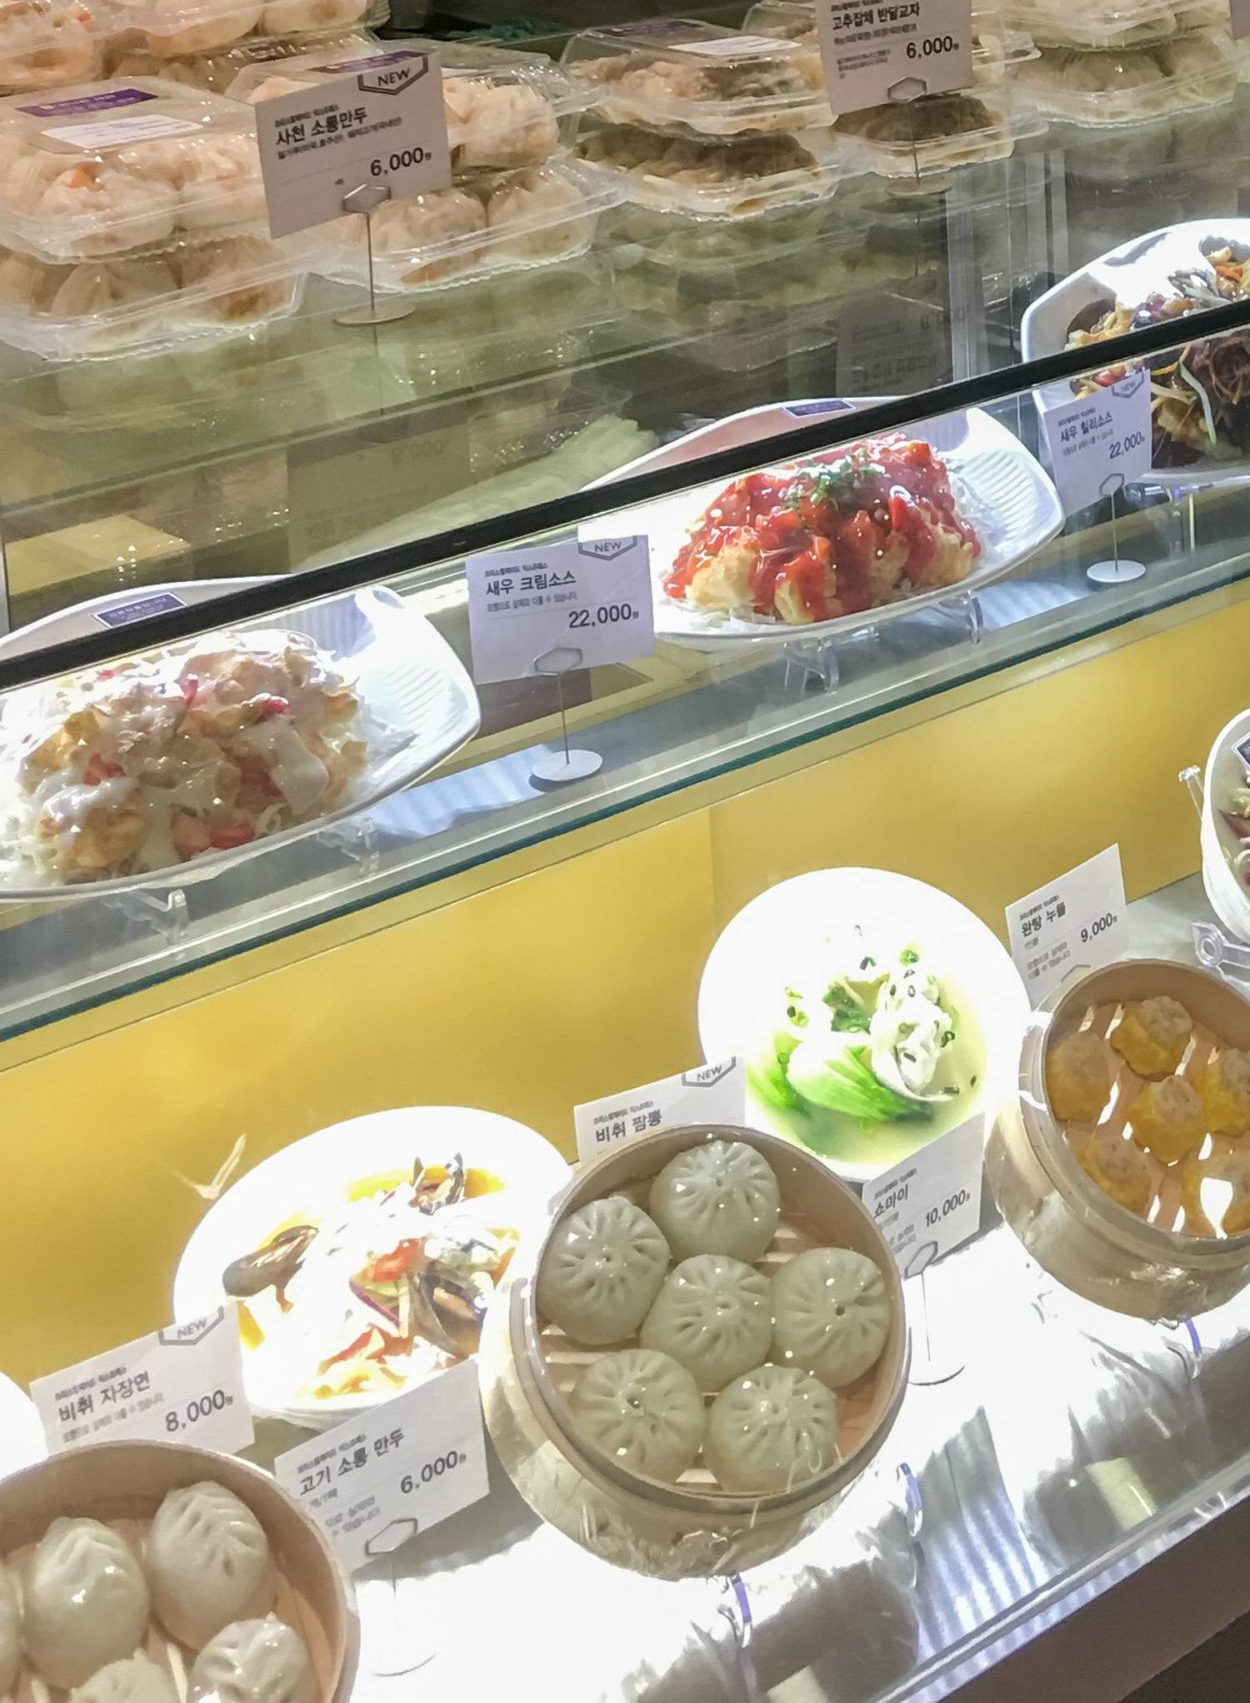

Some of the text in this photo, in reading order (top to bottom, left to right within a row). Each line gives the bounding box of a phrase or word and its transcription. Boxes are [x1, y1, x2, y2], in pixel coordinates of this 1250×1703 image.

[377, 68, 411, 87] NEW
[276, 125, 305, 146] 사천
[594, 541, 622, 553] NEW
[486, 572, 577, 597] 새우 크림소스
[1021, 915, 1043, 938] 완탕
[696, 1064, 723, 1082] NEW
[595, 1109, 663, 1143] 비취 짬뽕
[177, 1318, 208, 1340] NEW
[58, 1395, 94, 1422] 비취
[101, 1371, 151, 1407] 자장면
[299, 1466, 331, 1496] 고기
[373, 1428, 406, 1458] 만두
